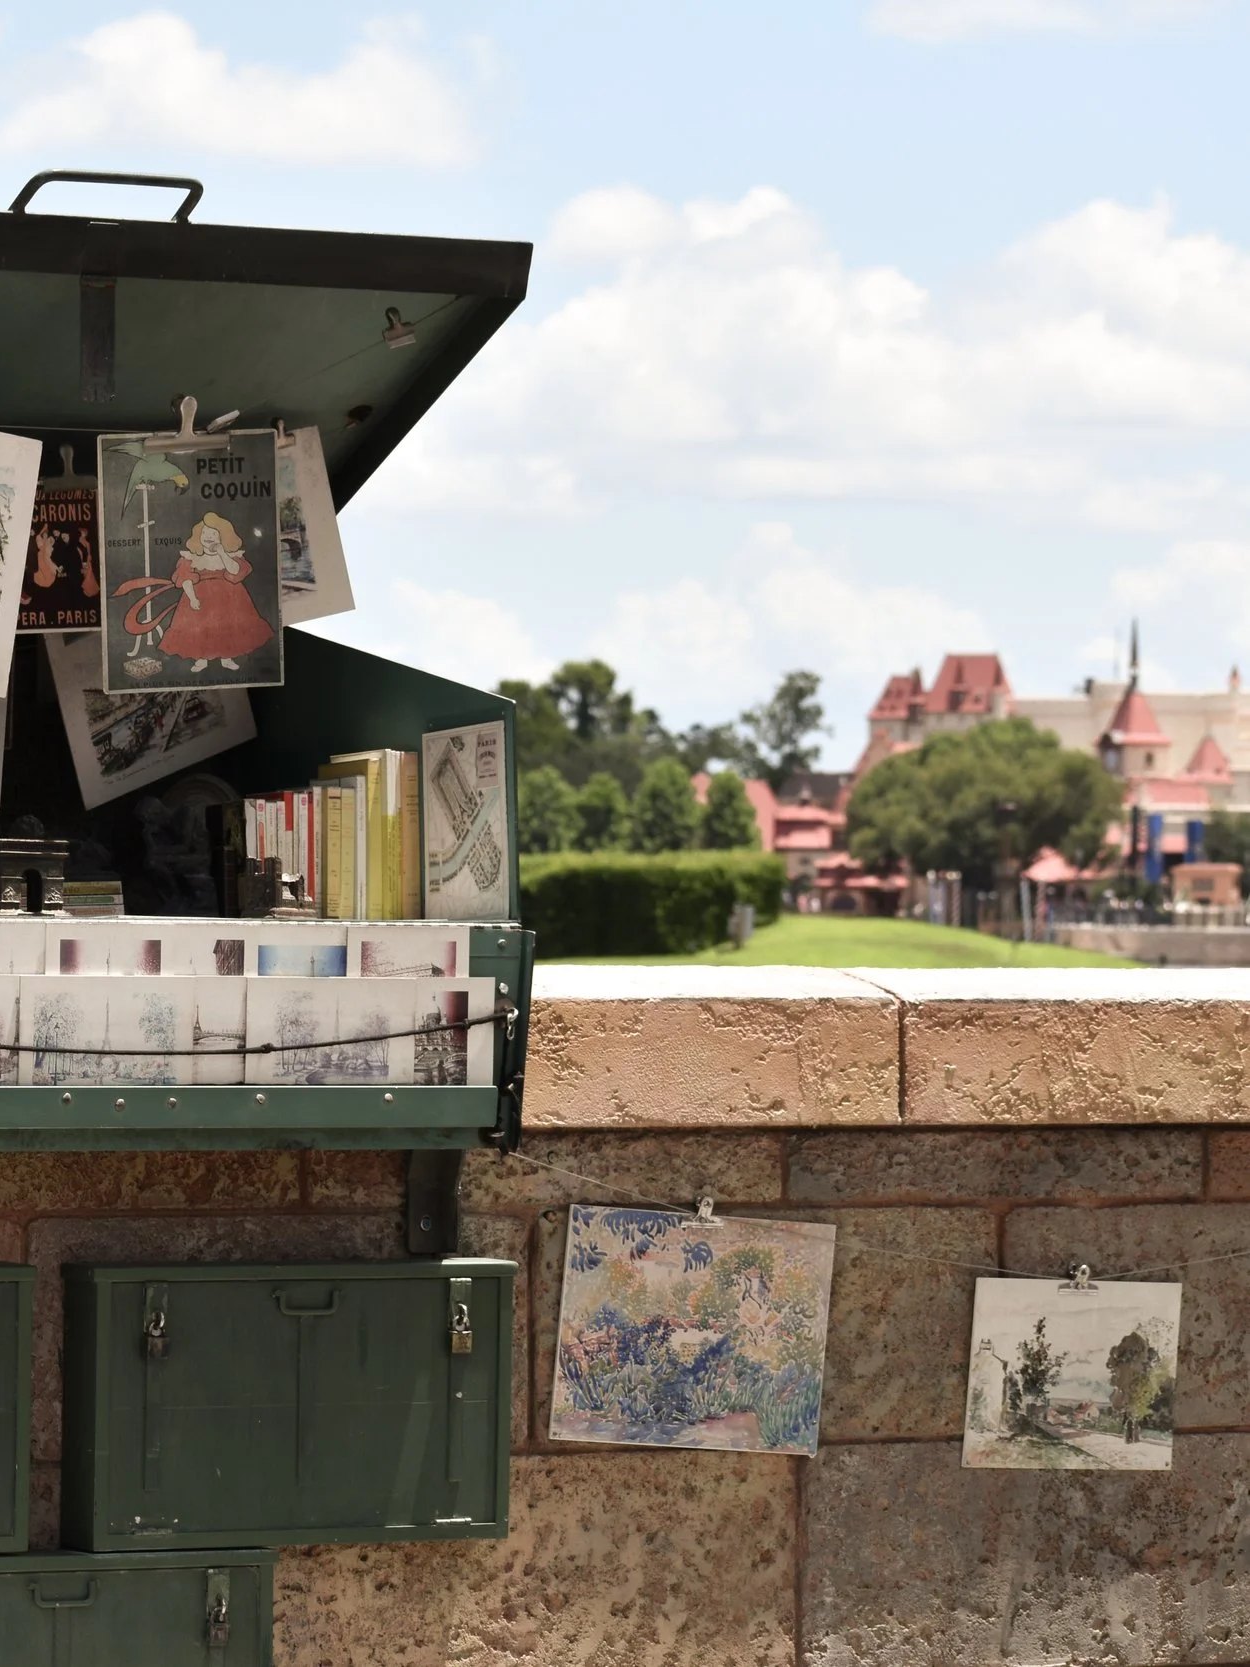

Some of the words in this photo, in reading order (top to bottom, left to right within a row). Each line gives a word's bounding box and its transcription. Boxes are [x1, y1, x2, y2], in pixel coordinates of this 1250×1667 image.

[107, 539, 142, 548] DESSERT
[154, 537, 183, 547] EXQUIS
[18, 611, 46, 626] ERA
[57, 609, 97, 625] PARIS
